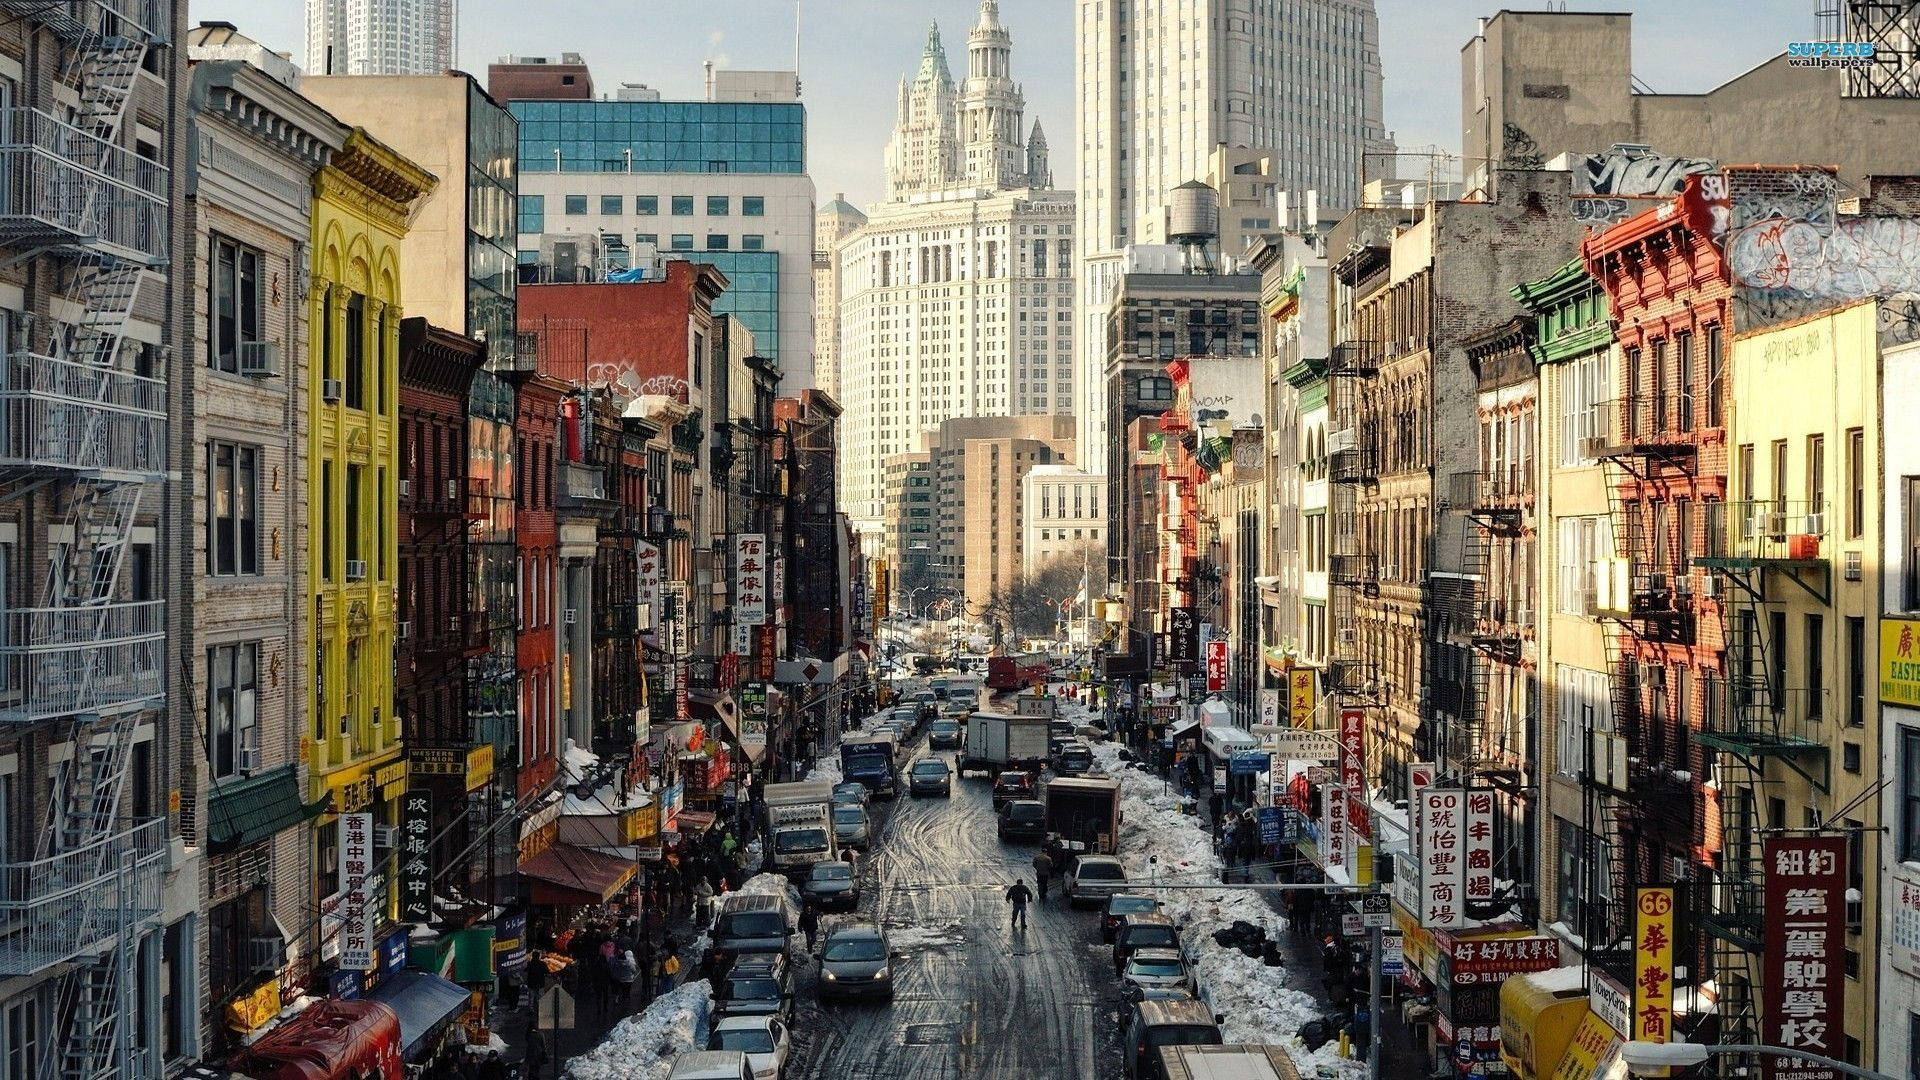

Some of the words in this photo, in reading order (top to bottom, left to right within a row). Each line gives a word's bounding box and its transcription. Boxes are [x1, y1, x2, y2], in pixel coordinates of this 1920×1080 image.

[1194, 395, 1234, 407] WOMP
[1640, 892, 1671, 915] 66
[1454, 940, 1558, 962] 好好駕駛學校
[1458, 972, 1474, 983] 62
[1481, 972, 1493, 982] TEL
[1780, 888, 1828, 1049] 第一駕駛學校
[1638, 922, 1669, 1044] 華豐商
